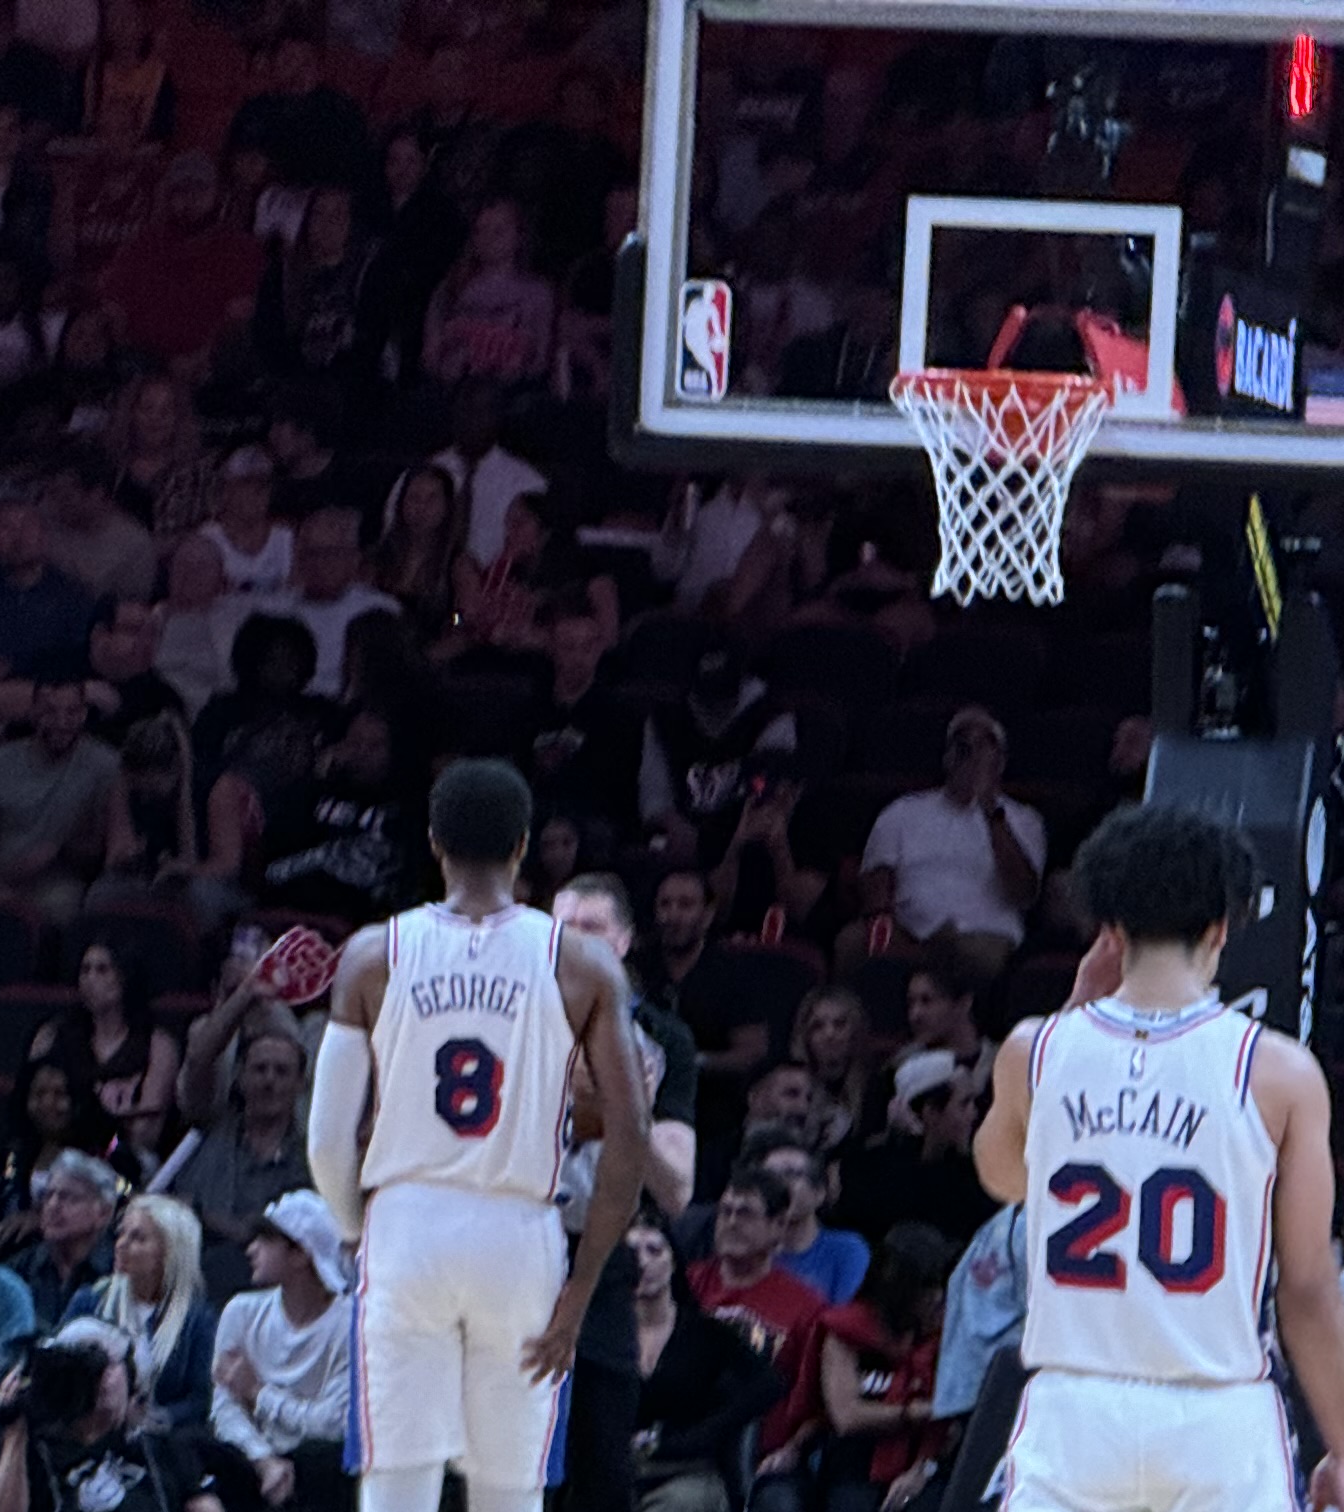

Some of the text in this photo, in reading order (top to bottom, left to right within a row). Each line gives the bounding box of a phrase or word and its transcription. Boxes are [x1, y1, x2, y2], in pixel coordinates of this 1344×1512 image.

[411, 973, 526, 1020] GEORGE
[435, 1037, 504, 1139] 8
[1061, 1087, 1207, 1150] McCAIN
[1046, 1162, 1226, 1295] 20
